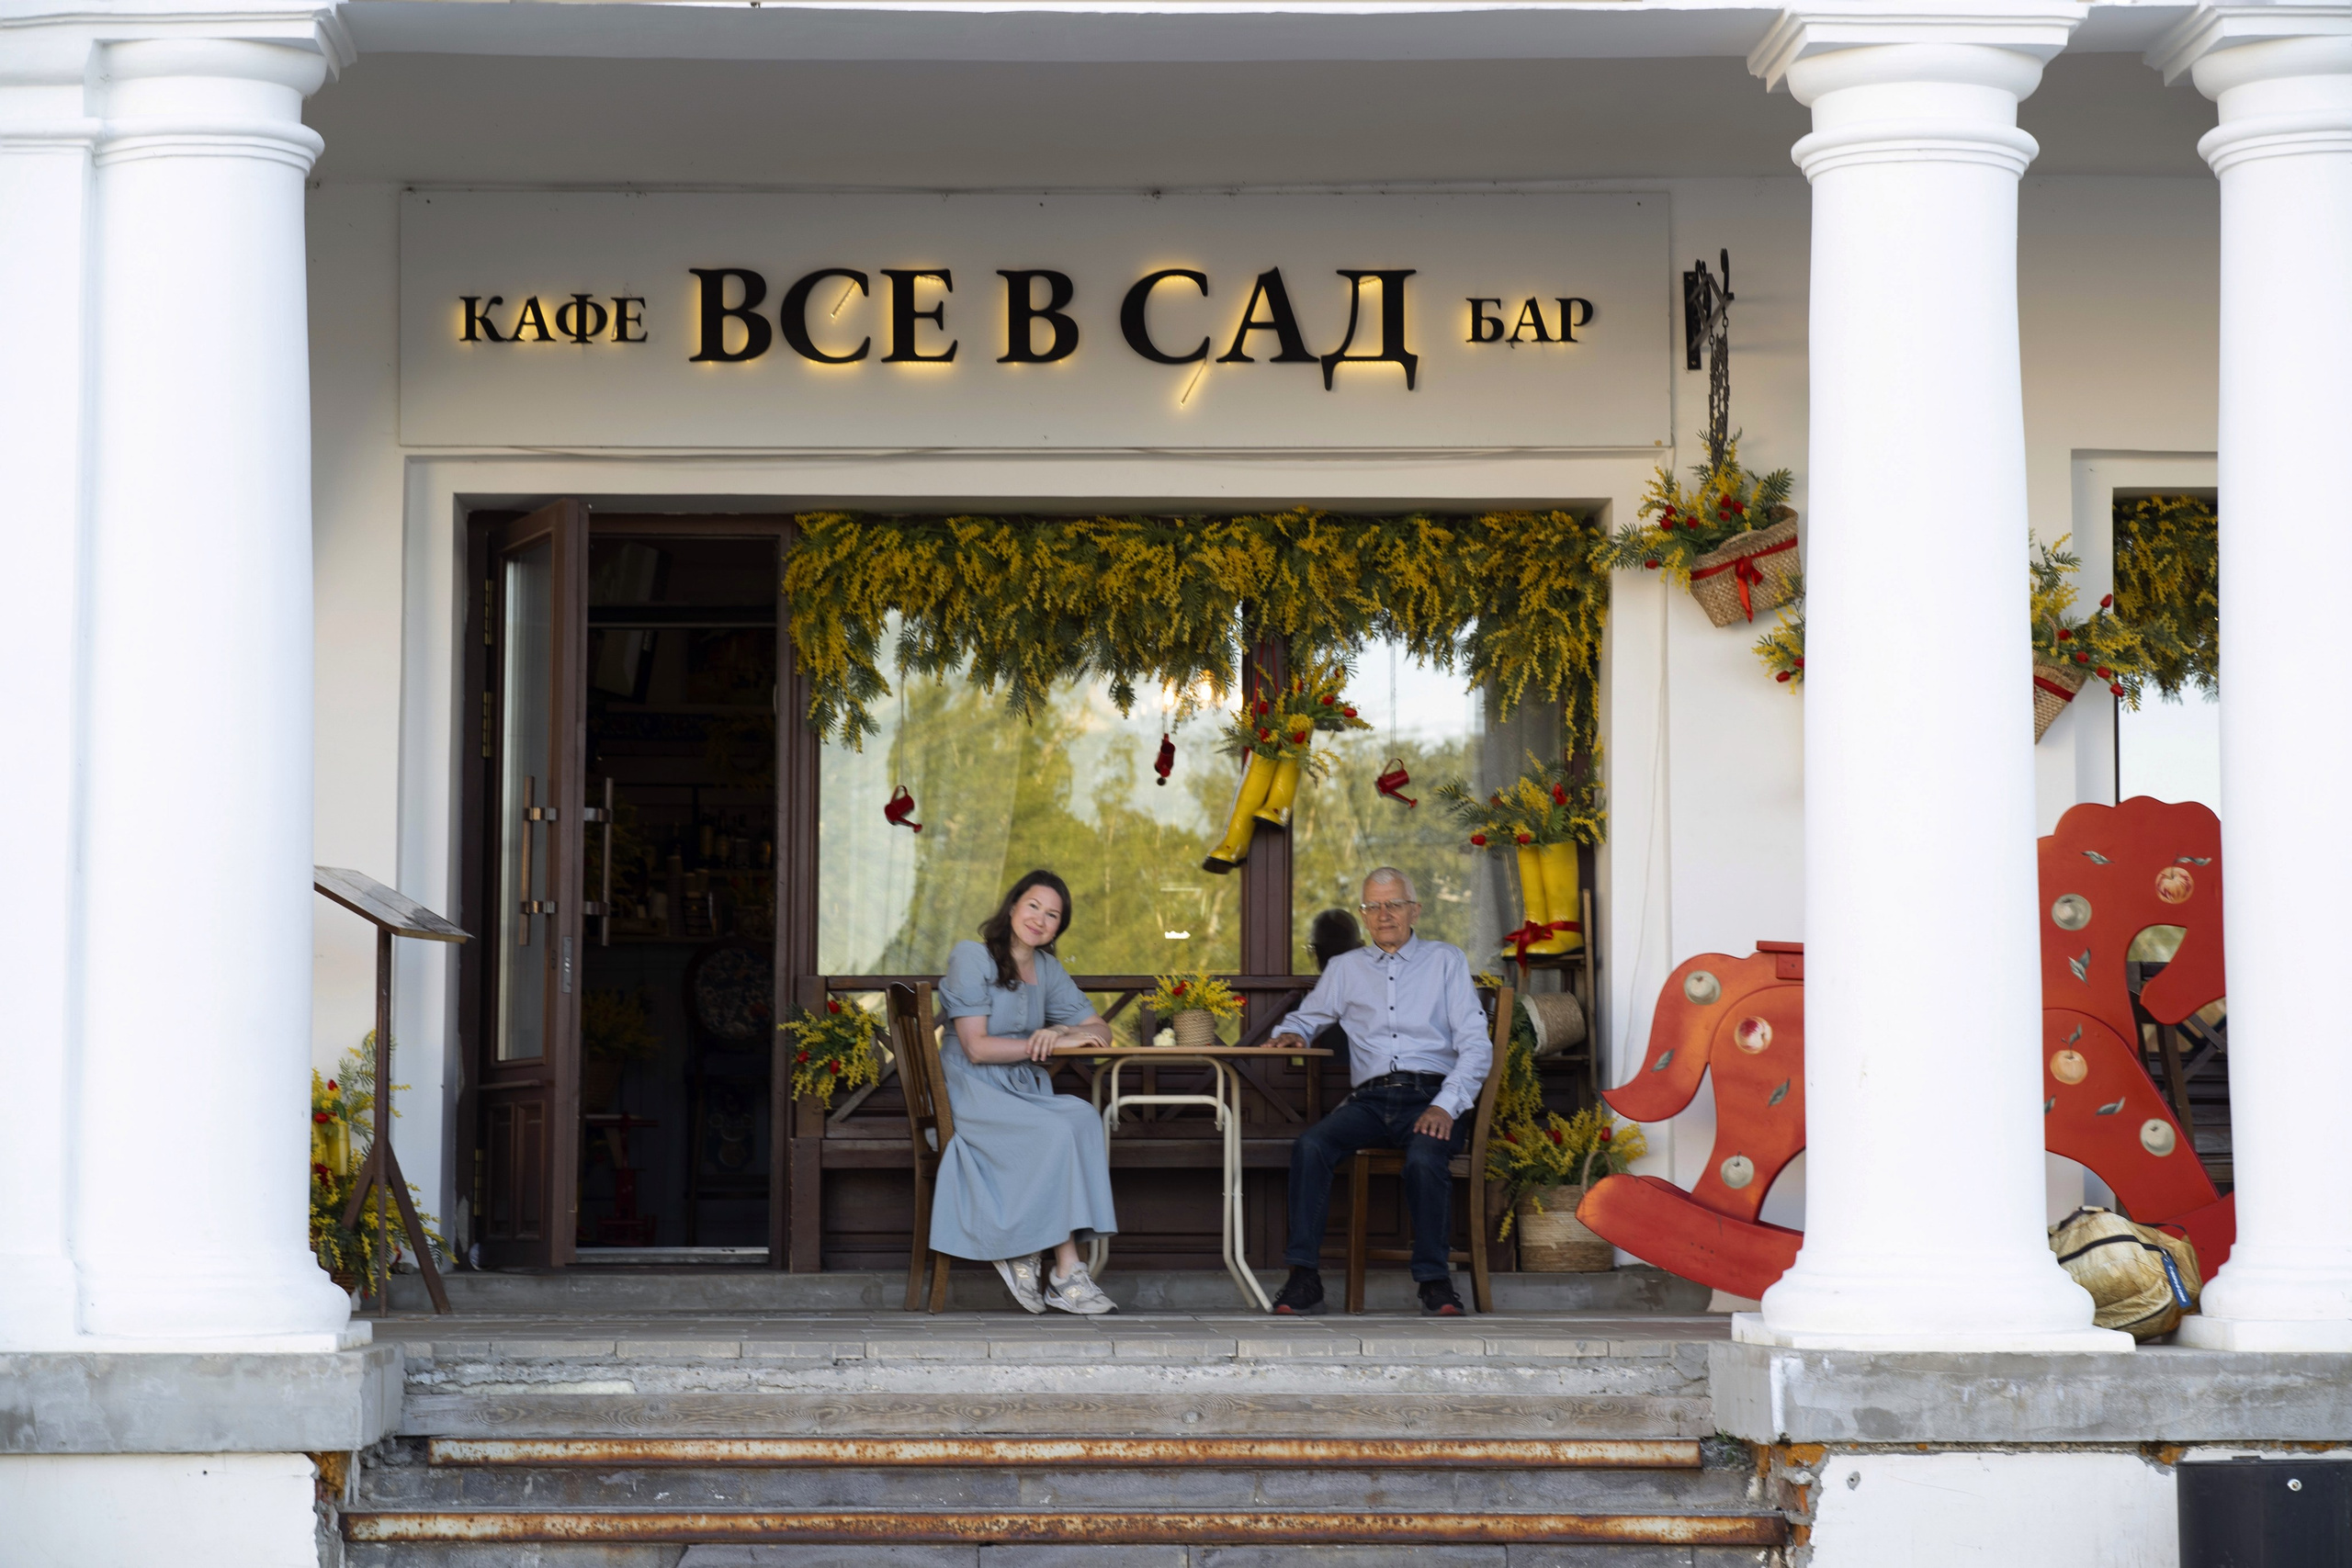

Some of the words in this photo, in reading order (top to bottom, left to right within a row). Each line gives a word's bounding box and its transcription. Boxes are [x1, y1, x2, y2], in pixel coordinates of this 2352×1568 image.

[458, 293, 649, 344] КАФЕ
[688, 267, 958, 364] ВСЕ
[996, 268, 1080, 364] В
[1119, 265, 1419, 391] САД
[1465, 295, 1594, 344] БАР
